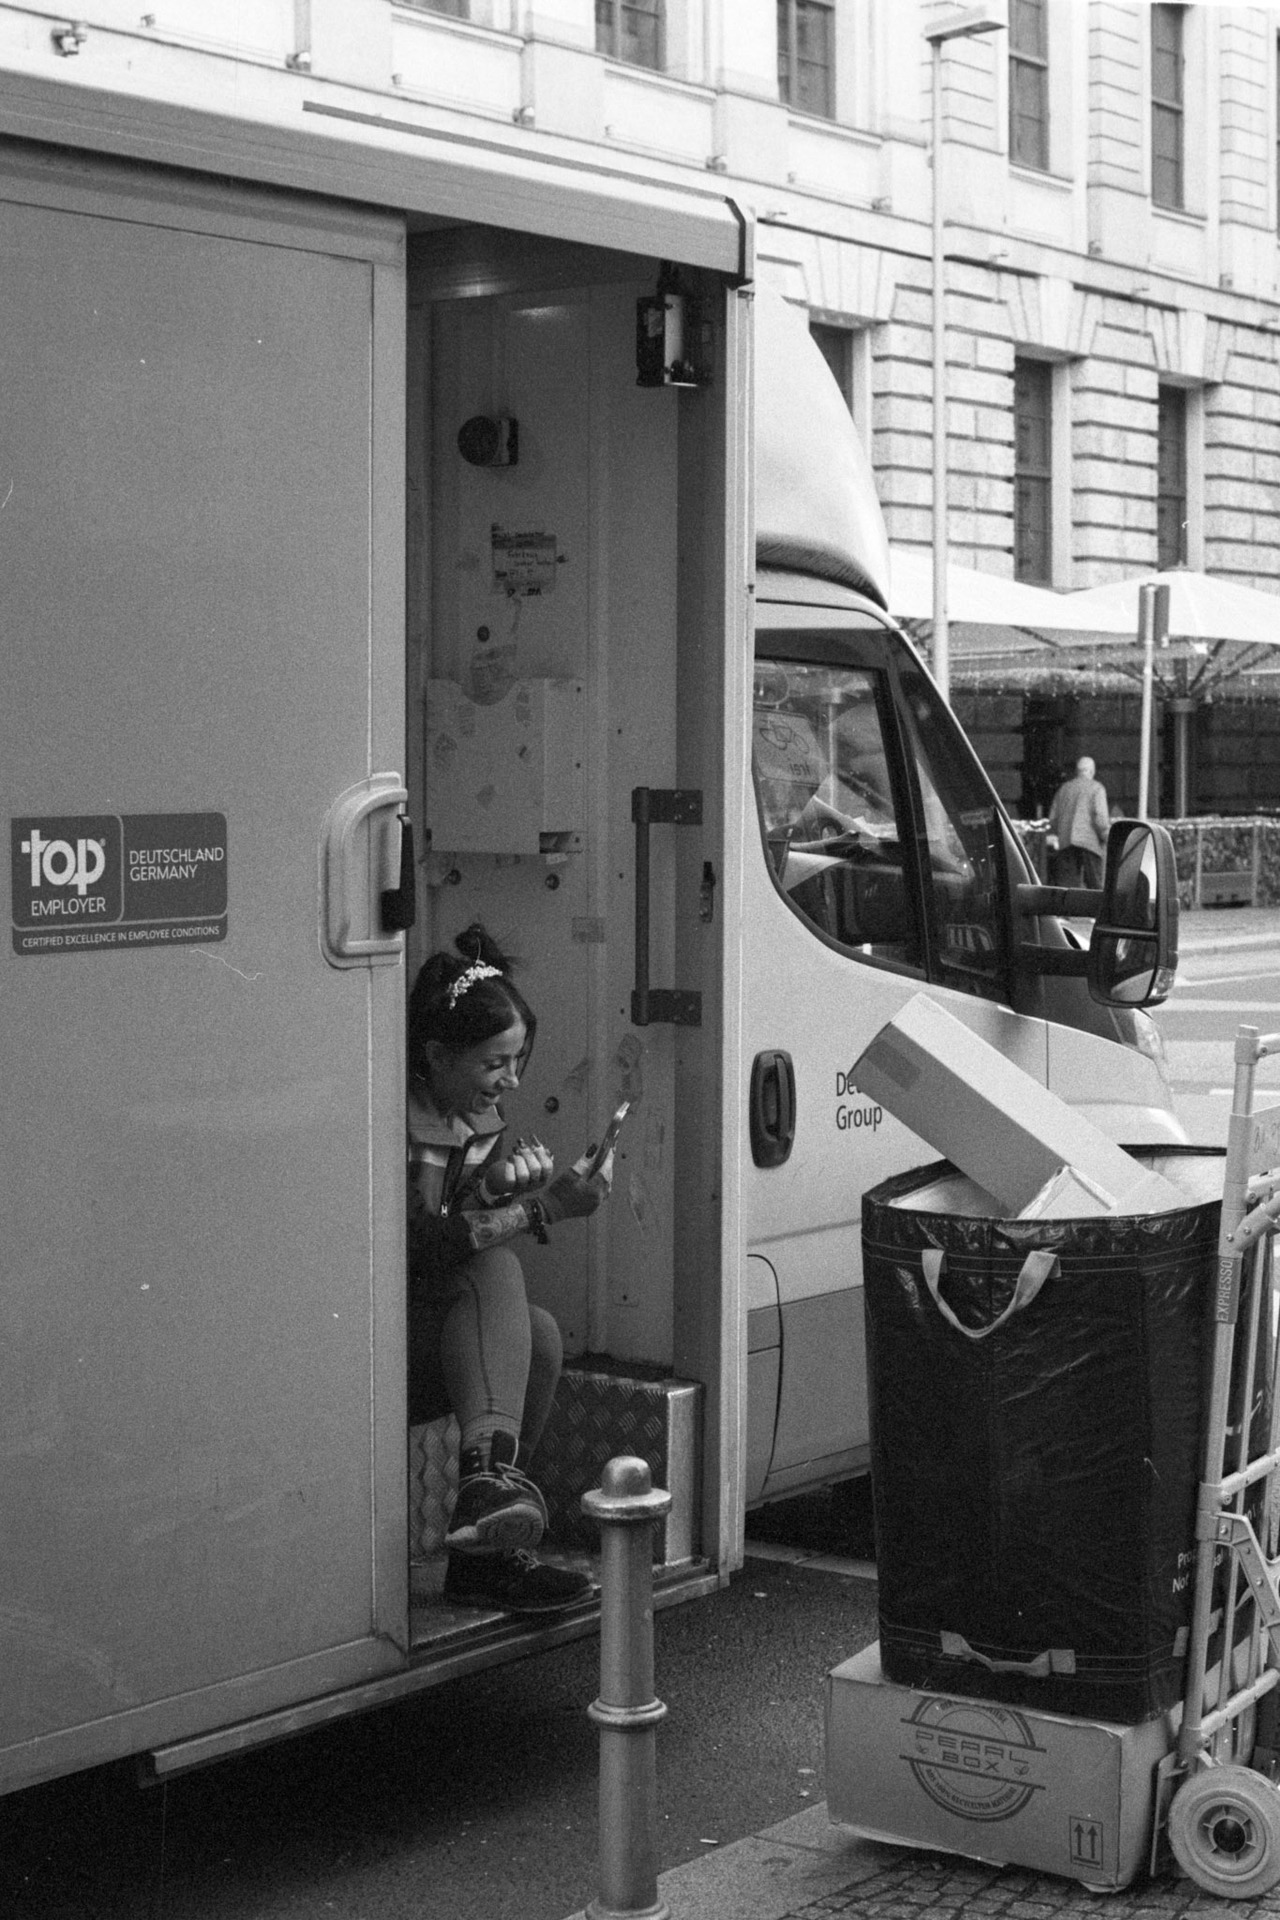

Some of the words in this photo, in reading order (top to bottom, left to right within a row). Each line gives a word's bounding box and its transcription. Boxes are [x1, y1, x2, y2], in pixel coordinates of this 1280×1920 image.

[21, 829, 105, 896] top
[129, 847, 225, 865] DEUTSCHLAND
[129, 865, 198, 882] GERMANY
[31, 897, 107, 917] EMPLOYER
[22, 935, 63, 948] CERTIFIED
[65, 932, 117, 946] EXCELLENCE
[118, 932, 127, 942] IN
[128, 928, 170, 941] EMPLOYEE
[171, 925, 220, 938] CONDITIONS
[836, 1105, 883, 1132] Group
[1216, 1260, 1233, 1322] EXPRESSO
[916, 1729, 1030, 1765] PEARL
[942, 1750, 1001, 1773] BOX
